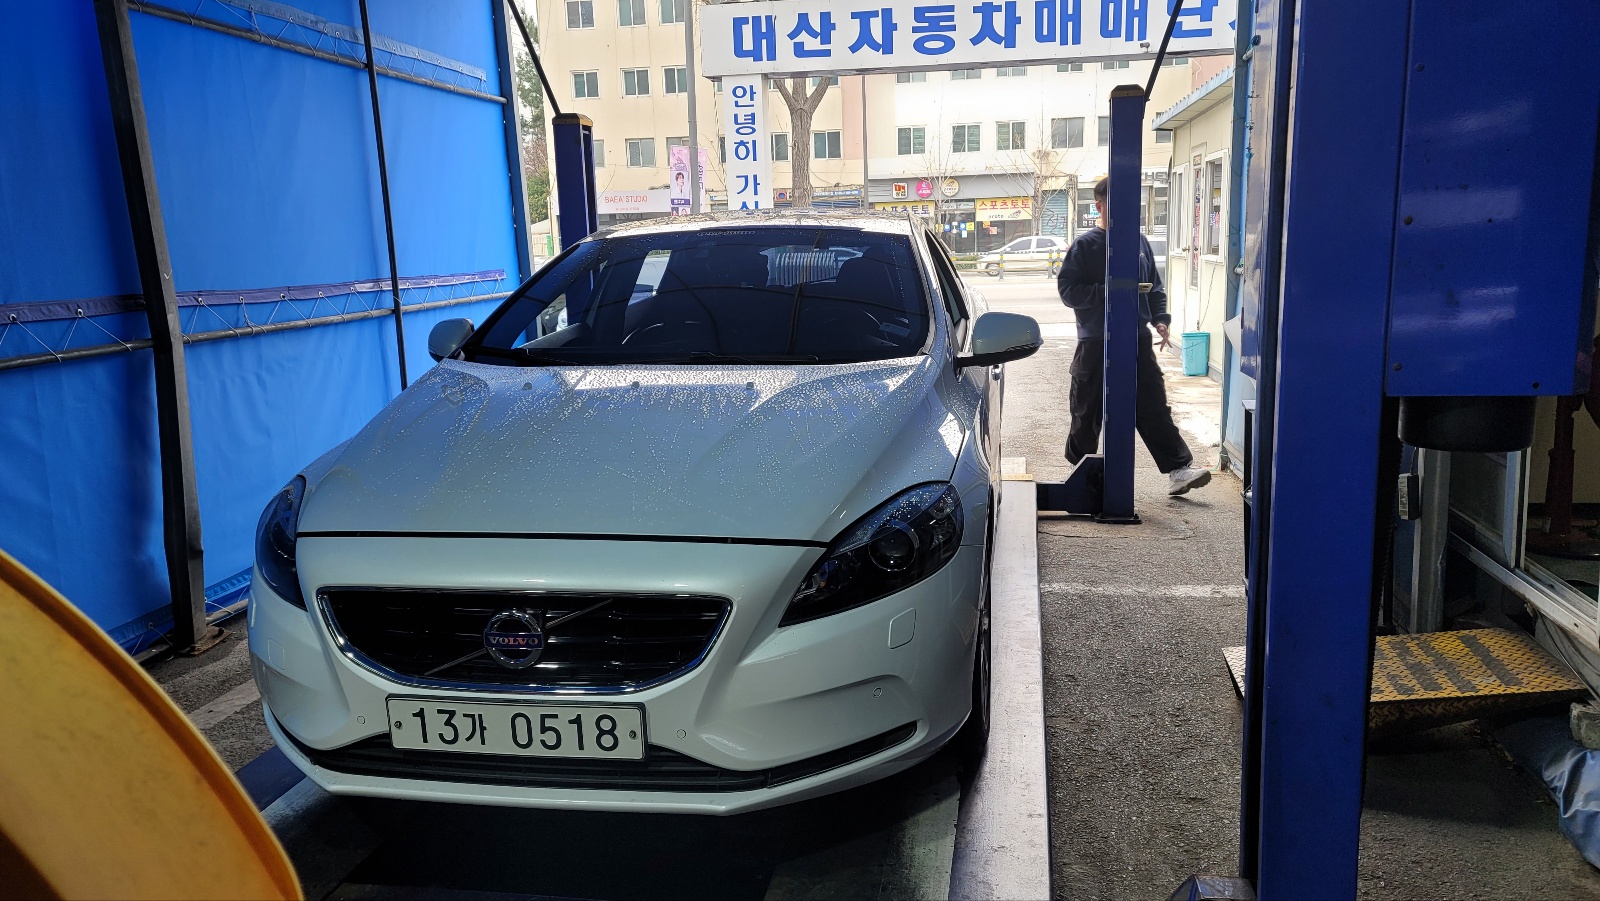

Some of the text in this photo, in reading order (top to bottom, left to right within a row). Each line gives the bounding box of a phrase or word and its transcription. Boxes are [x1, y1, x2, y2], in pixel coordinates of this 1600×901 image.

[732, 0, 1236, 61] 대산자동차매매단
[732, 84, 758, 161] 안녕히
[979, 199, 1030, 210] 스포츠토토
[487, 635, 539, 646] VOLVO
[411, 706, 619, 752] 13가 0518
